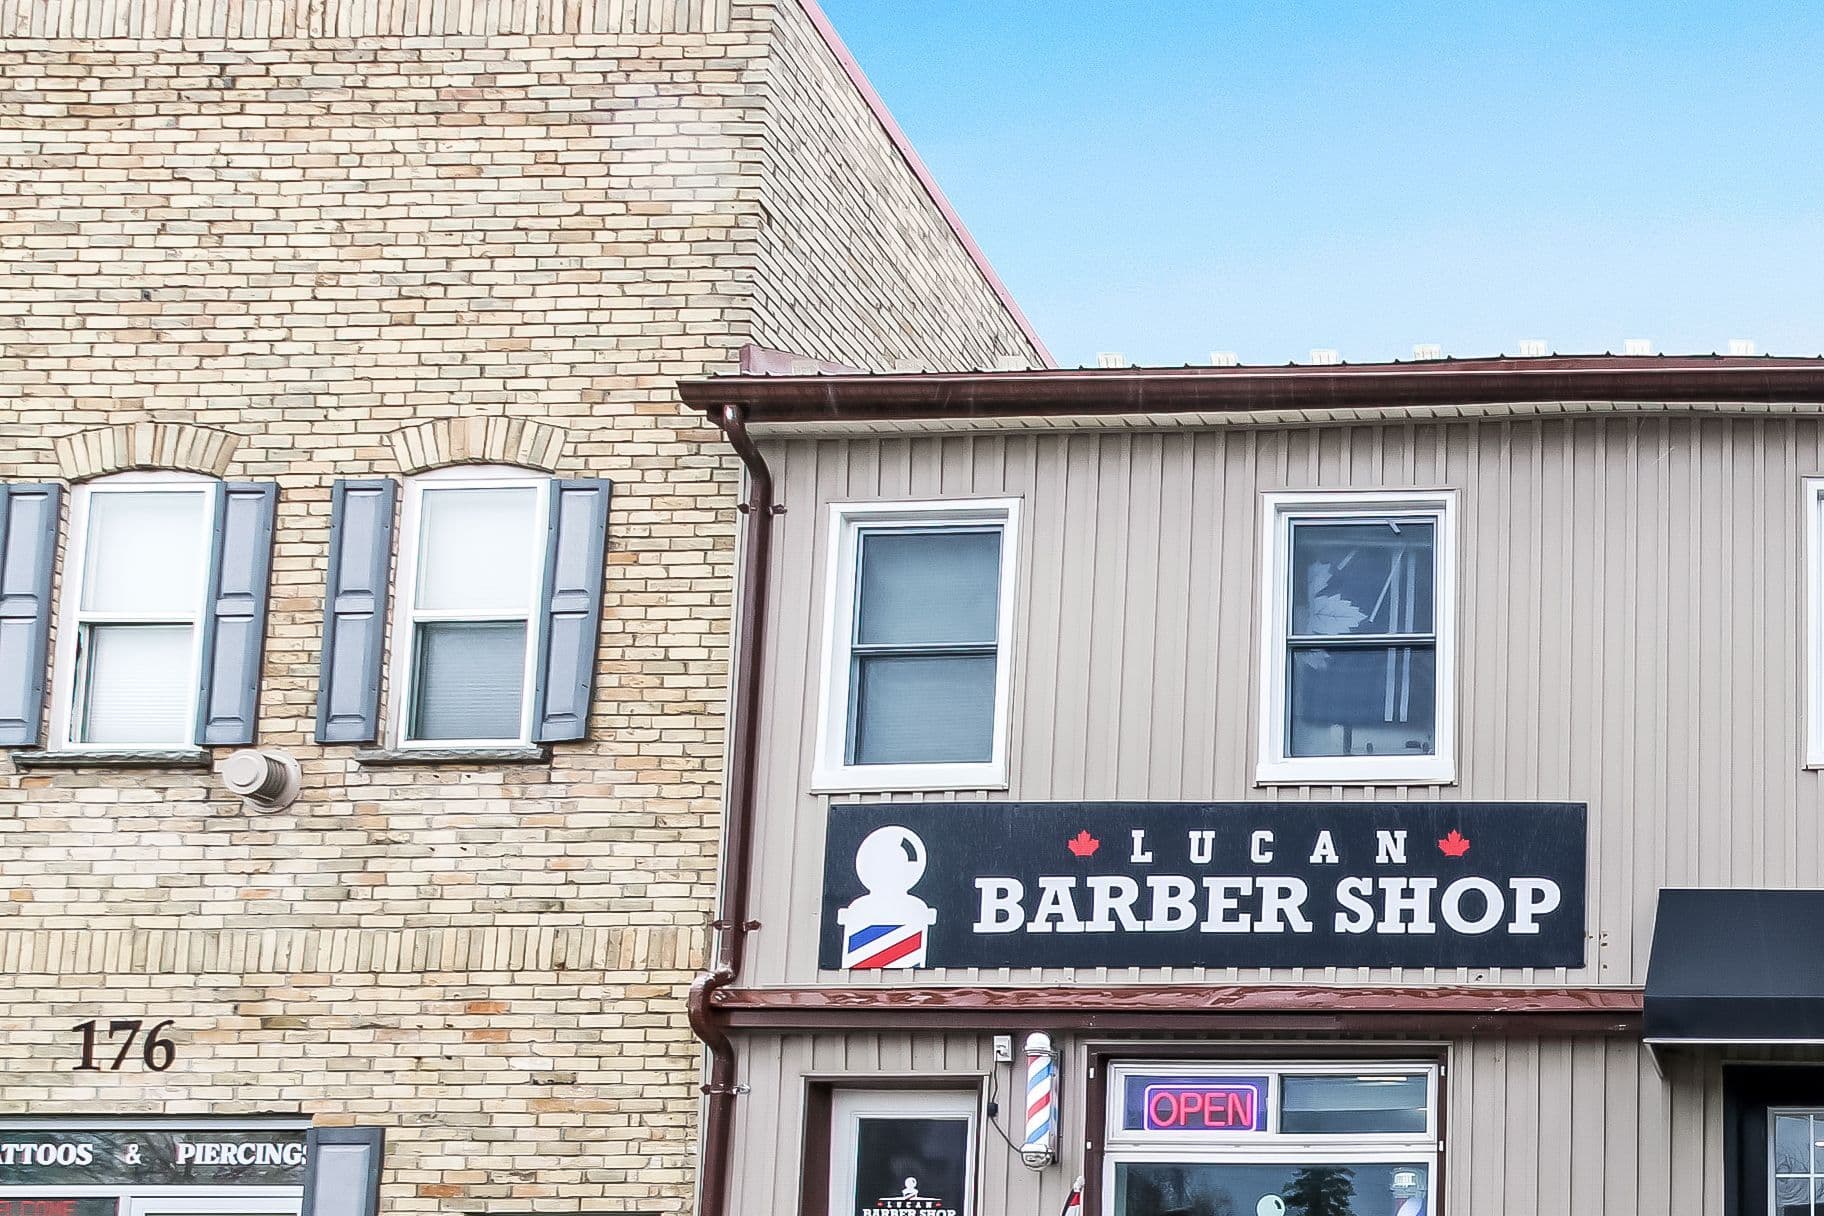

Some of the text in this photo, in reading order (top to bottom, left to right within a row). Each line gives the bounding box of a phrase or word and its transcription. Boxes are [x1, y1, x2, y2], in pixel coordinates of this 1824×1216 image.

[1130, 829, 1408, 864] LUCAN
[973, 875, 1562, 935] BARBER SHOP
[72, 1019, 176, 1072] 176
[1149, 1092, 1253, 1127] OPEN
[0, 1142, 307, 1166] TTOOS & PIERCING
